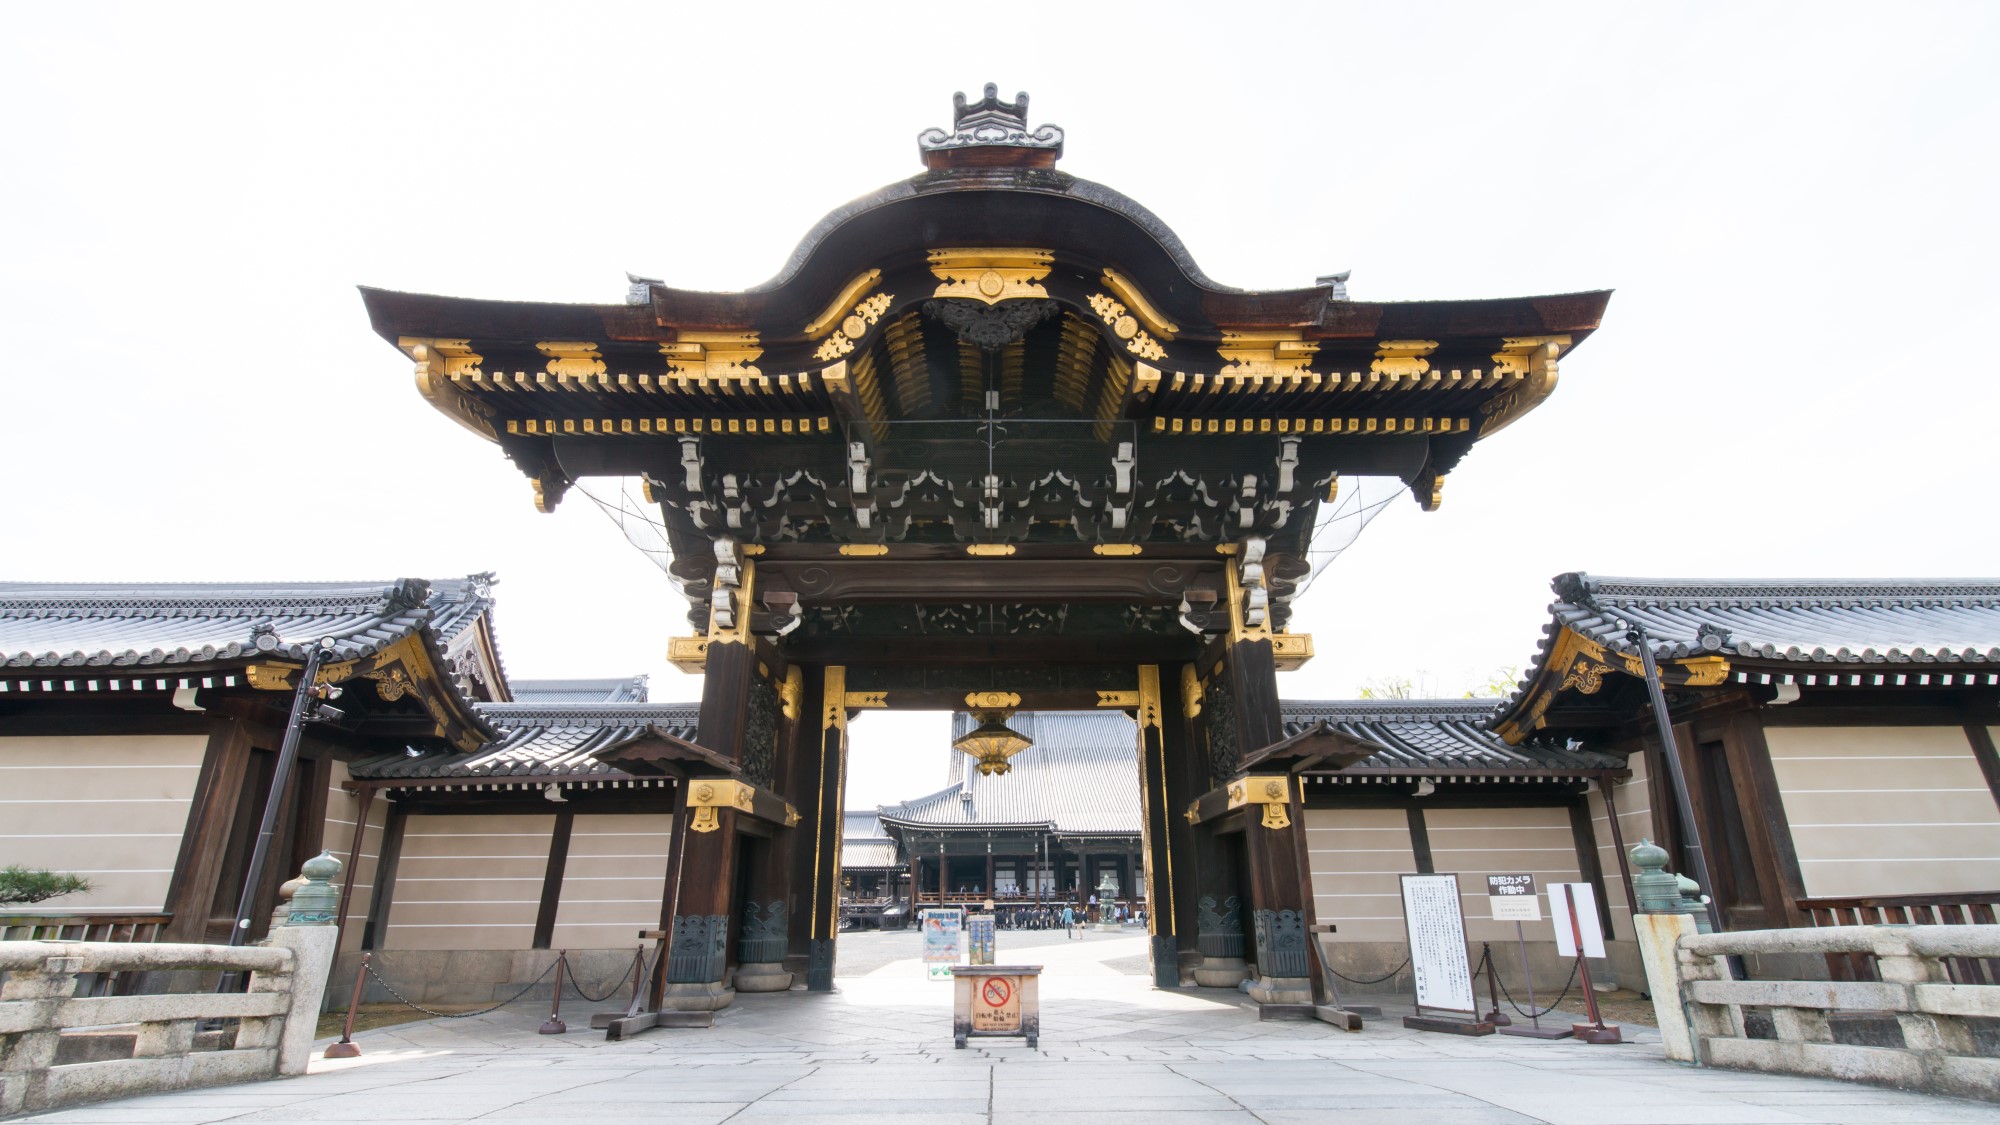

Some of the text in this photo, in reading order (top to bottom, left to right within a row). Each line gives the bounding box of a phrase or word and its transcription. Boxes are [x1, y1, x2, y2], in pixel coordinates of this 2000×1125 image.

[1489, 876, 1530, 885] 防犯カメラ
[1499, 885, 1525, 894] 作動中
